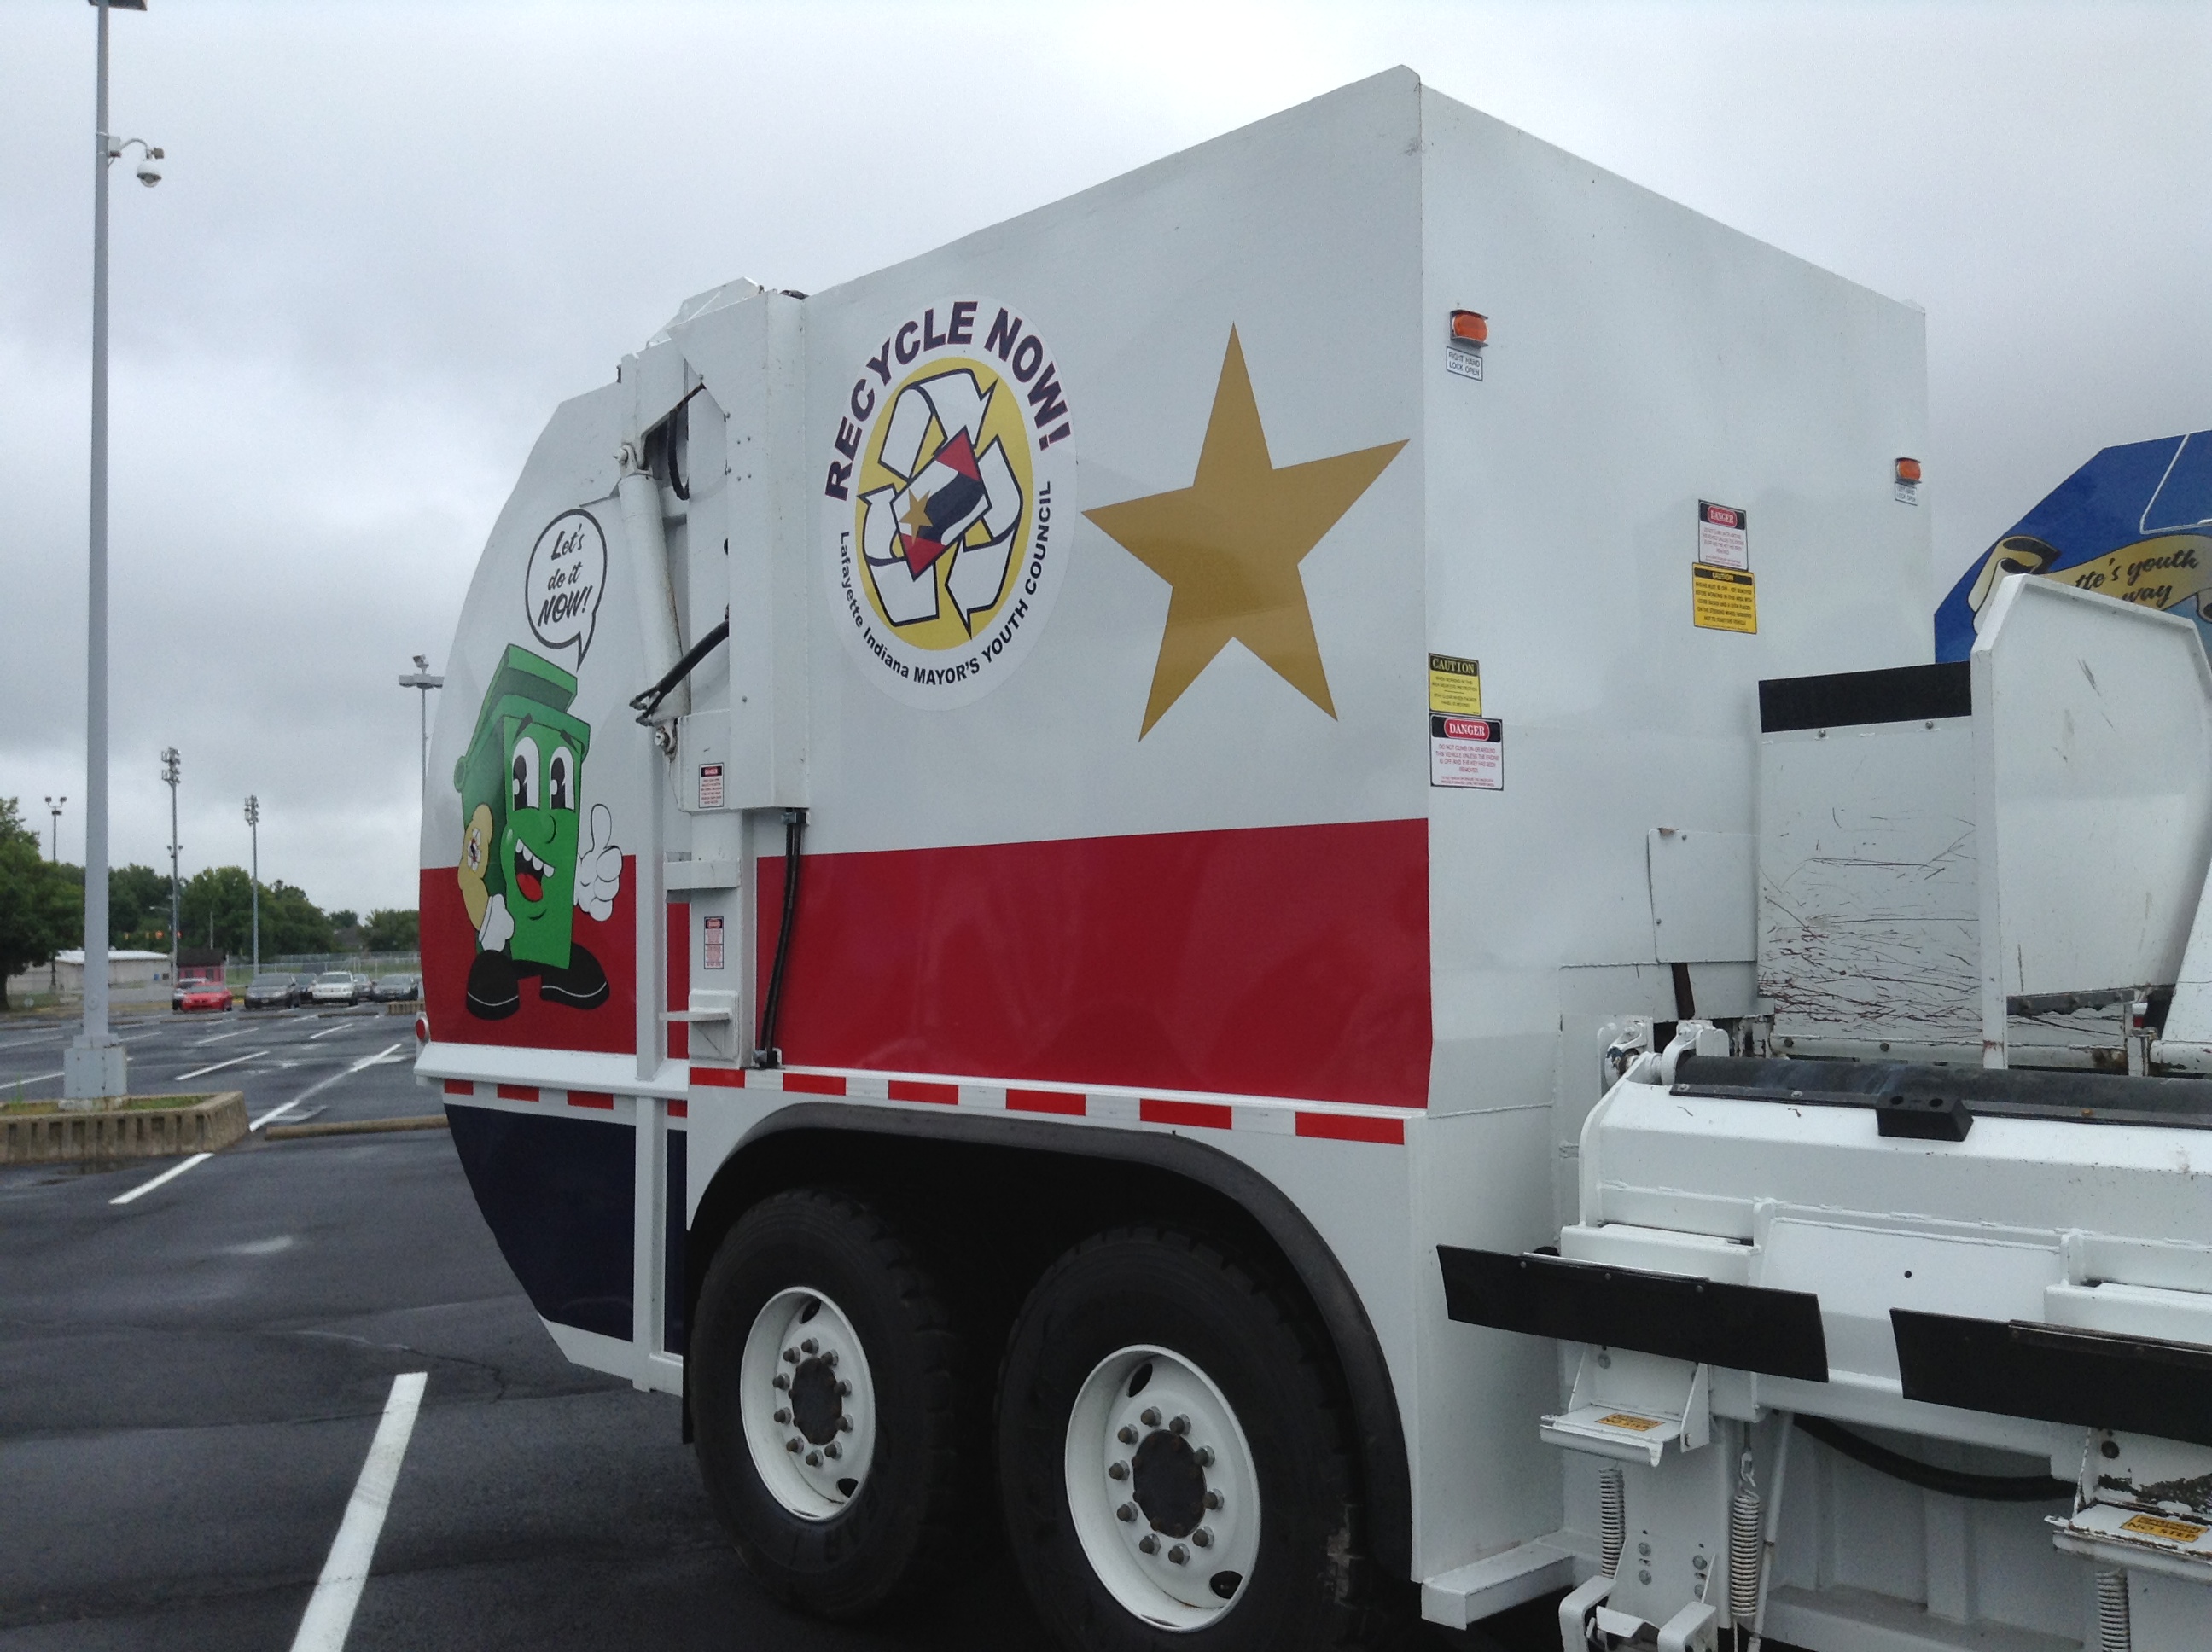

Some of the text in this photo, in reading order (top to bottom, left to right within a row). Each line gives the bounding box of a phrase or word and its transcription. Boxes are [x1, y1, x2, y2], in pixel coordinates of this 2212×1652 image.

[1465, 366, 1480, 376] OPEN
[824, 301, 1071, 501] RECYCLE NOW!
[550, 523, 585, 561] Let's
[548, 561, 583, 590] do it
[840, 480, 1051, 685] Lafayette Indiana MAYOR'S YOUTH COUNCIL
[2127, 549, 2199, 586] youth
[538, 585, 593, 627] NOW!
[1432, 659, 1475, 674] CAUTION
[1448, 723, 1485, 736] DANGER
